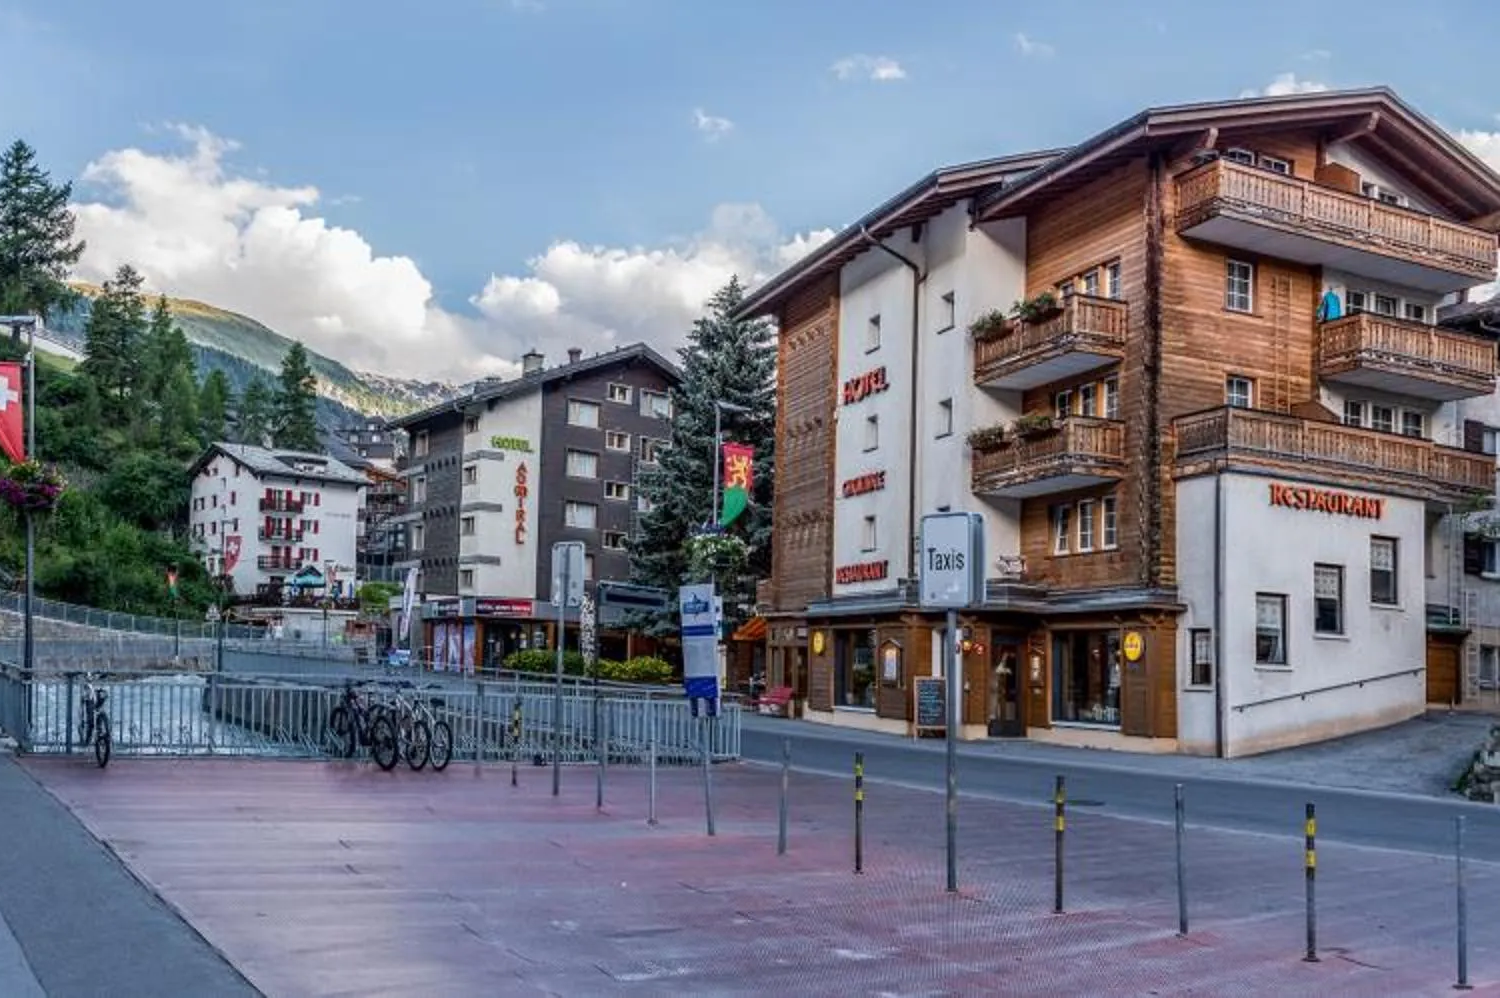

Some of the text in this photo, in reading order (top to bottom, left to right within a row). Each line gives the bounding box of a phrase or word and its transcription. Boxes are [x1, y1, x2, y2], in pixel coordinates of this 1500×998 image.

[843, 366, 890, 404] HOTEL
[491, 435, 533, 453] HOTEL
[1269, 482, 1387, 519] RESTAURANT
[927, 547, 965, 571] Taxis
